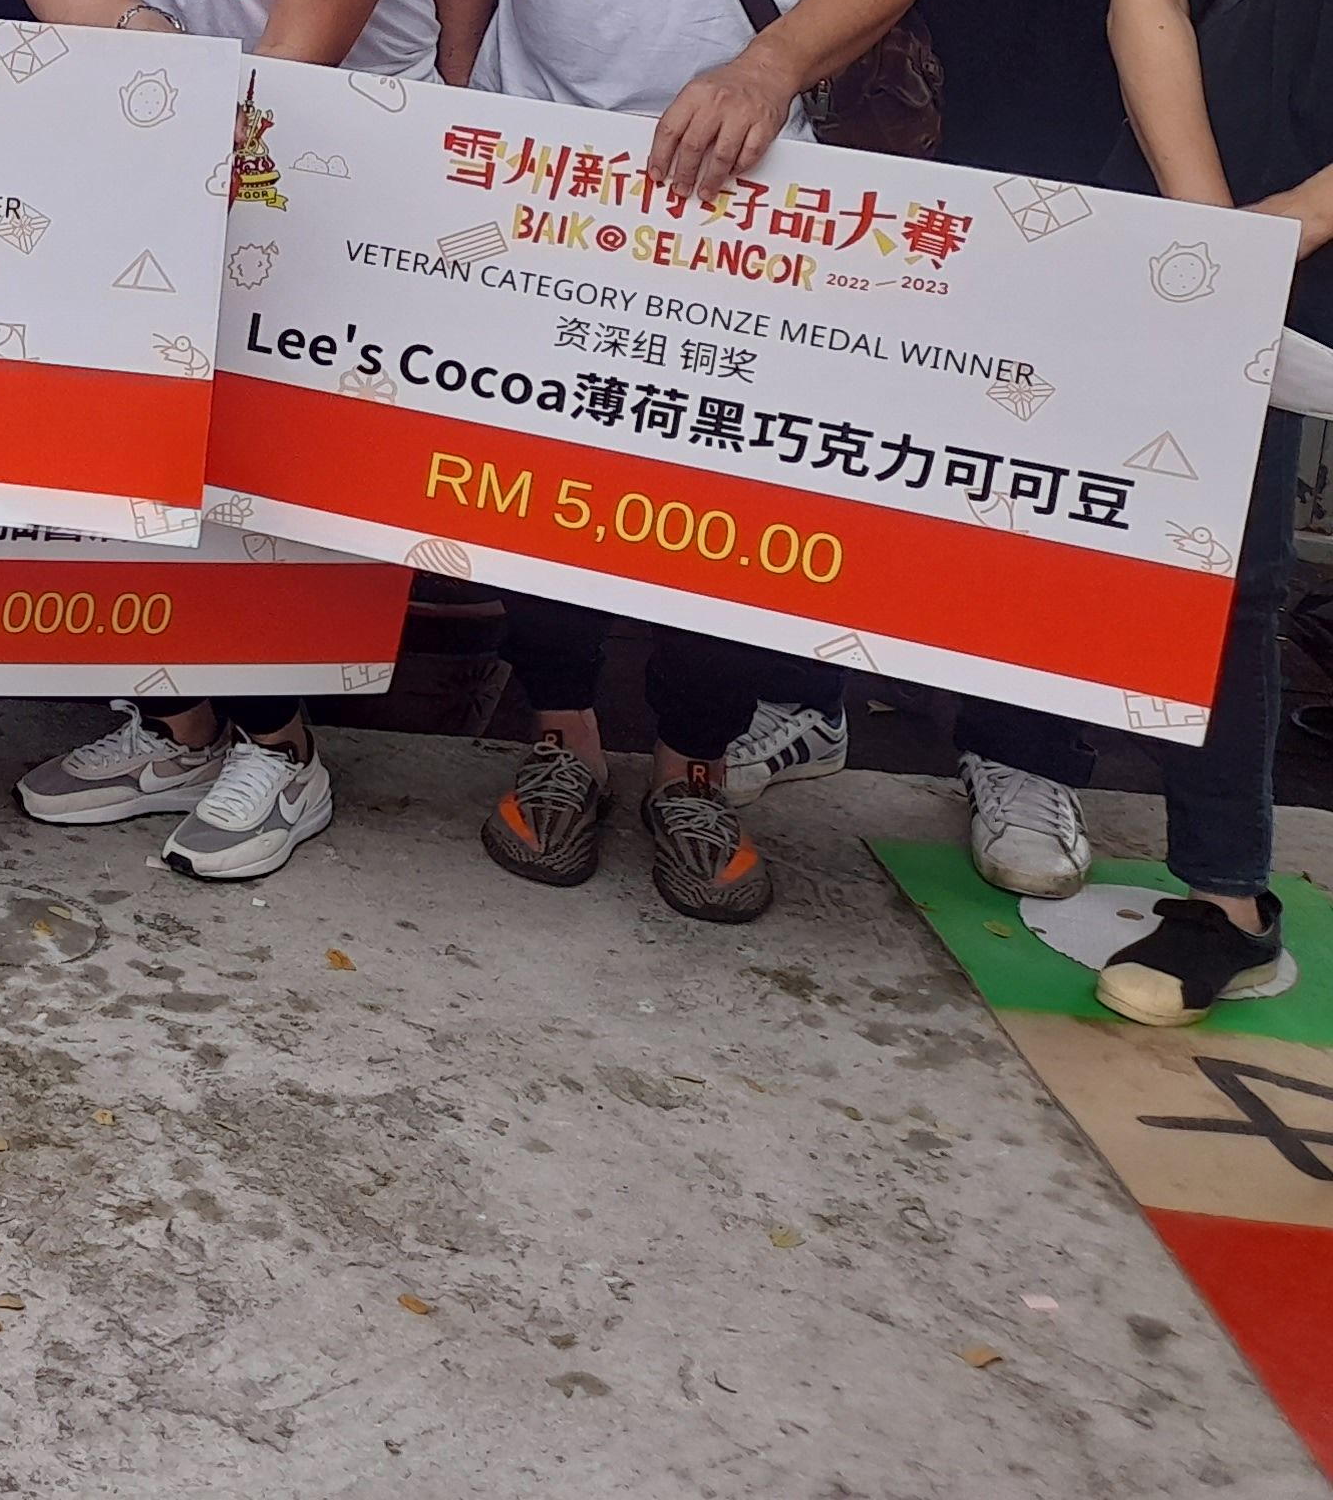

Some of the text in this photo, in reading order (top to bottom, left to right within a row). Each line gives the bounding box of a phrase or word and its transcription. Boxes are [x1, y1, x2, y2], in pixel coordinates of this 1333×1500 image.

[345, 241, 1035, 386] VETERAN CATEGORY BRONZE MEDAL WINNER
[826, 272, 871, 292] 2022
[901, 276, 950, 296] 2023
[247, 312, 383, 376] Lee's
[553, 315, 758, 384] 资深组 铜奖
[425, 452, 845, 586] RM 5,000.00
